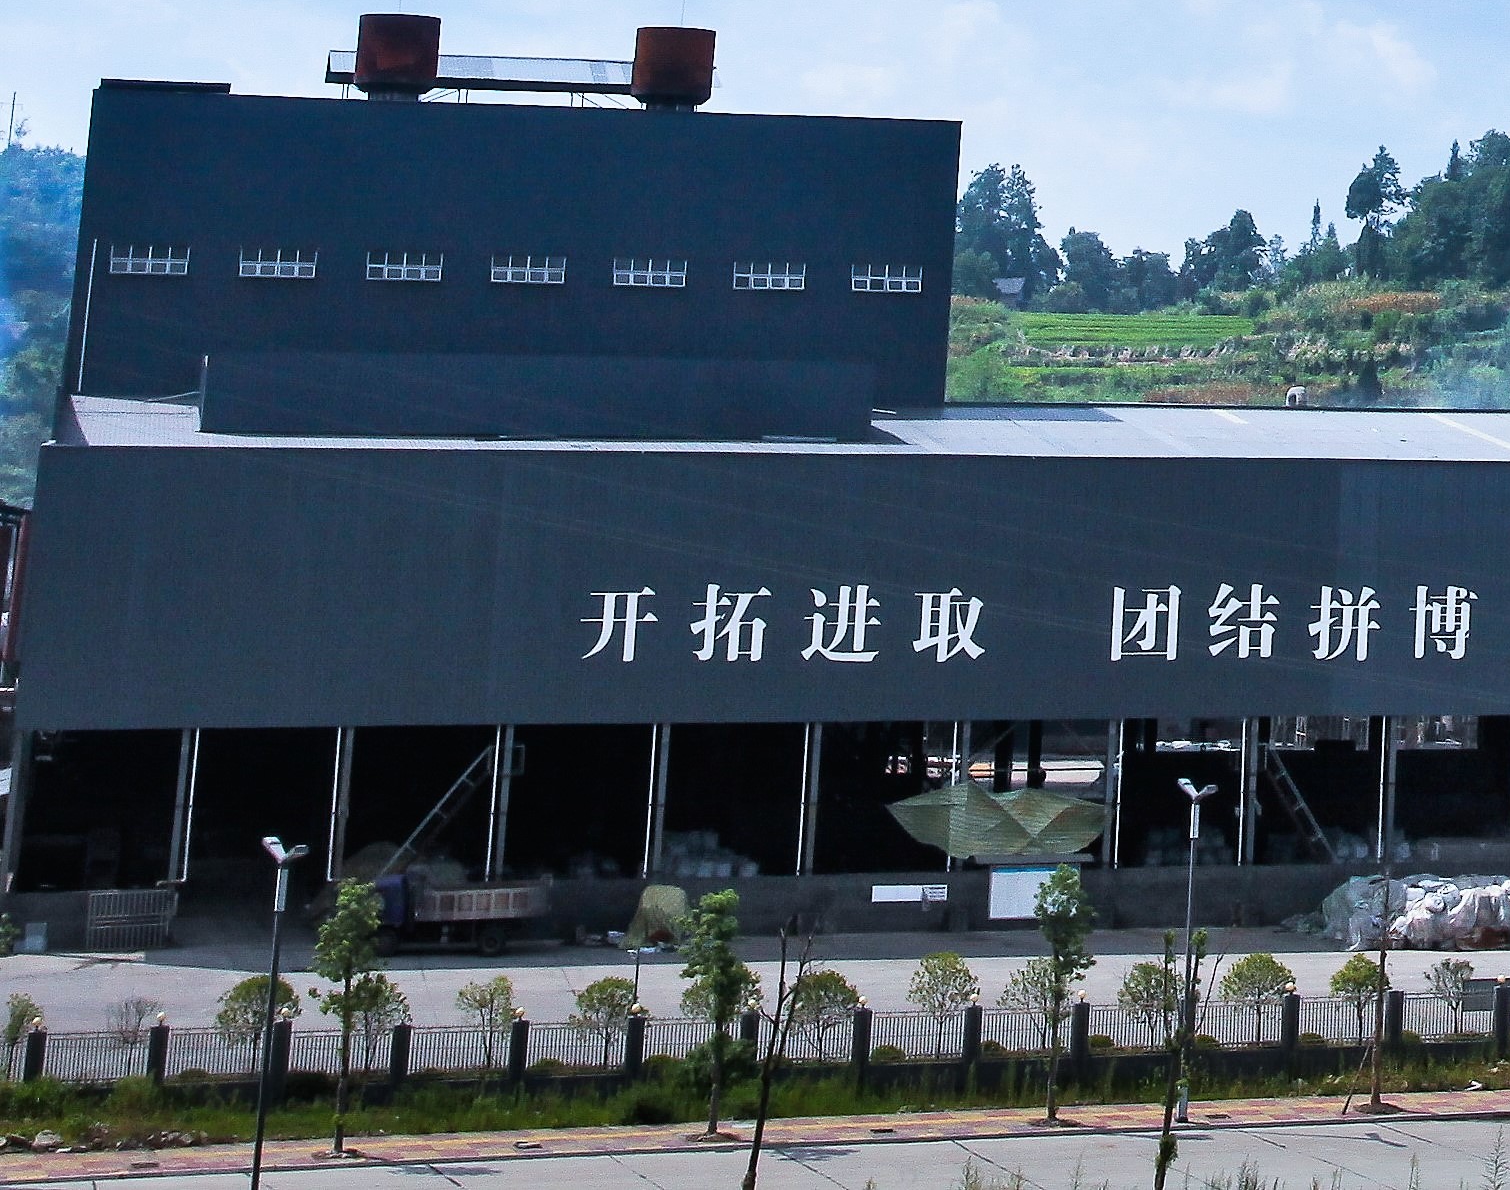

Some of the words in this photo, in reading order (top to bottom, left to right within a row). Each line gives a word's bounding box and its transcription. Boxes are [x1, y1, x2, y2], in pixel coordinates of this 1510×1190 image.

[580, 584, 986, 663] 开拓进取
[1110, 583, 1479, 662] 团结拼博
